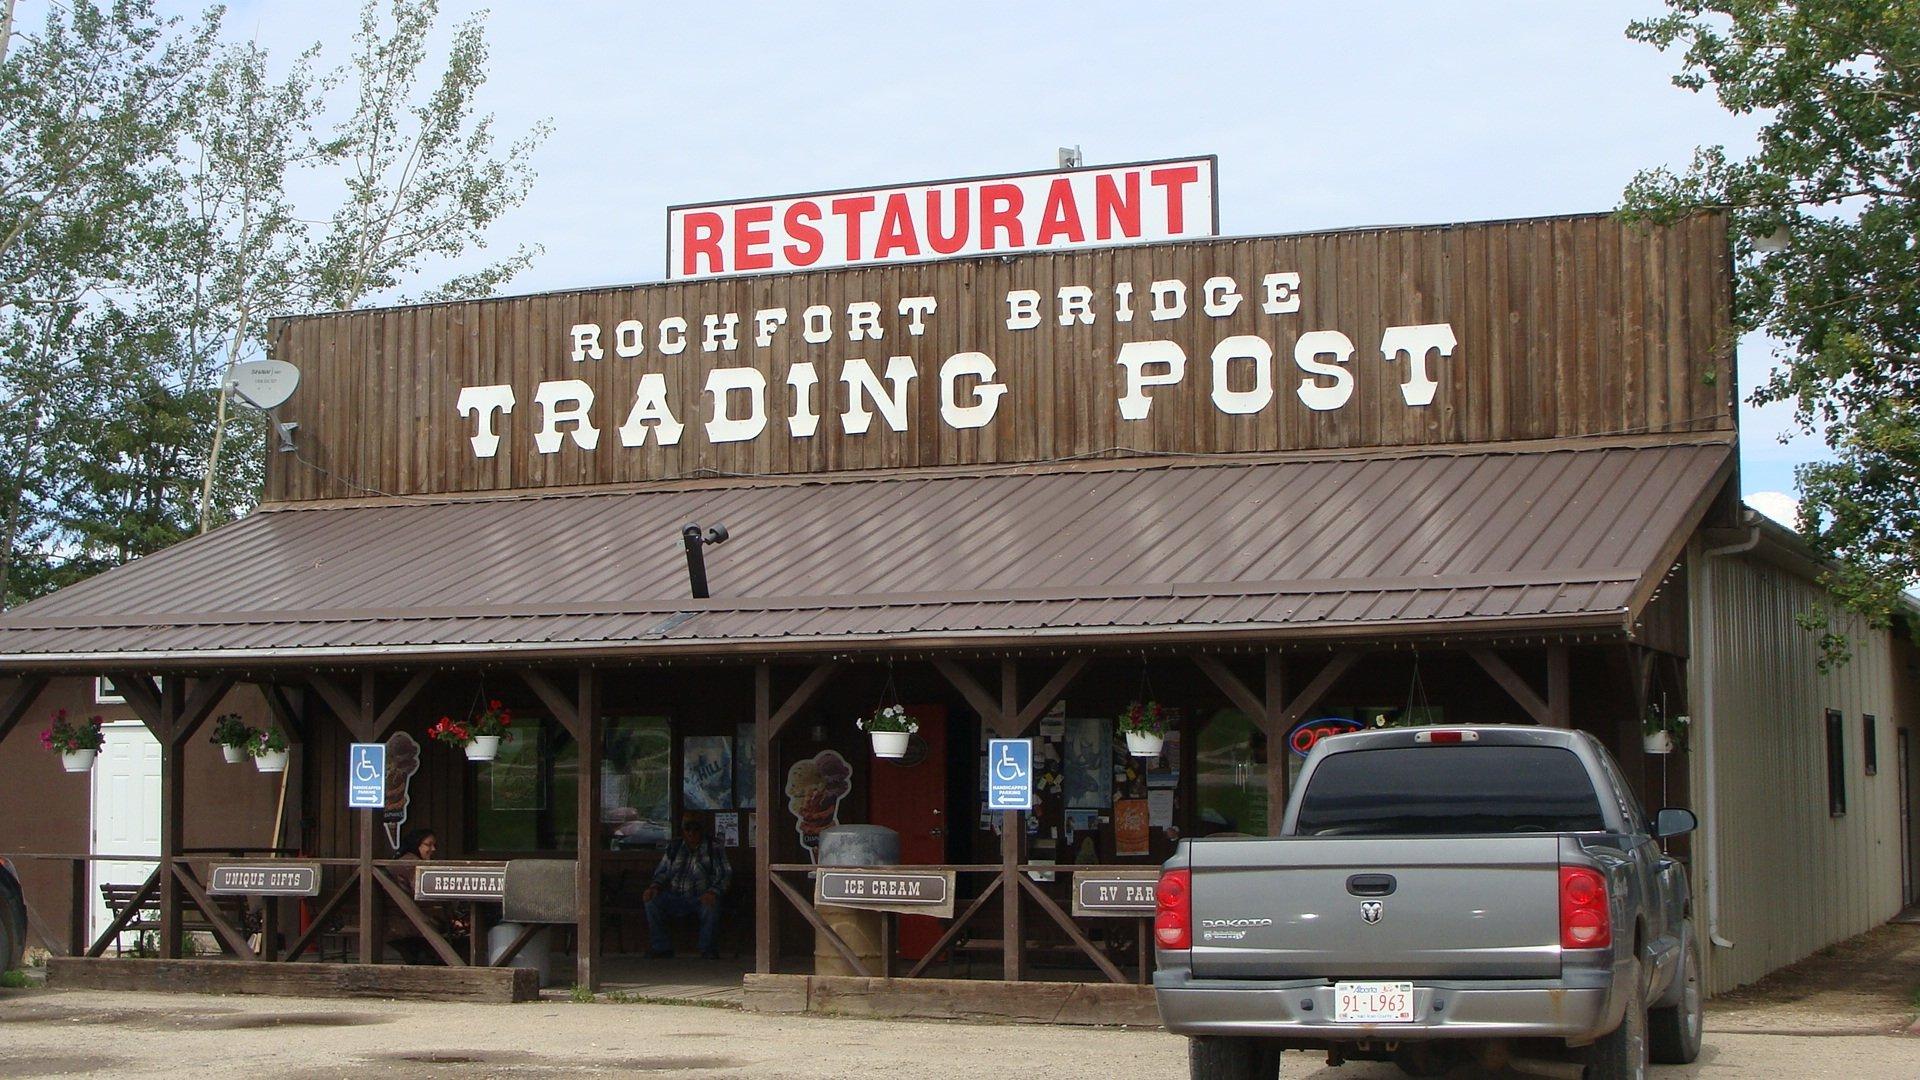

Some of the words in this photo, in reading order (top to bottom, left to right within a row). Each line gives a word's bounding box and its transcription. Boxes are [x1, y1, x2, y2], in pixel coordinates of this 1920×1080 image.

[682, 166, 1199, 276] RESTAURANT
[570, 295, 938, 363] ROCHFORT
[1004, 271, 1301, 331] BRIDGE
[455, 351, 1009, 459] TRADING
[1115, 322, 1458, 421] POST
[1293, 726, 1358, 751] OP
[225, 872, 265, 888] UNIQUE
[271, 873, 301, 887] GIFTS
[435, 876, 505, 892] RESTAURAN
[844, 879, 865, 896] ICE
[872, 880, 921, 897] CREAM
[1099, 886, 1118, 901] RV
[1126, 886, 1155, 901] PAR
[1202, 918, 1273, 928] DAKOTA
[1353, 985, 1378, 994] Alberta
[1342, 994, 1405, 1012] 91-L963
